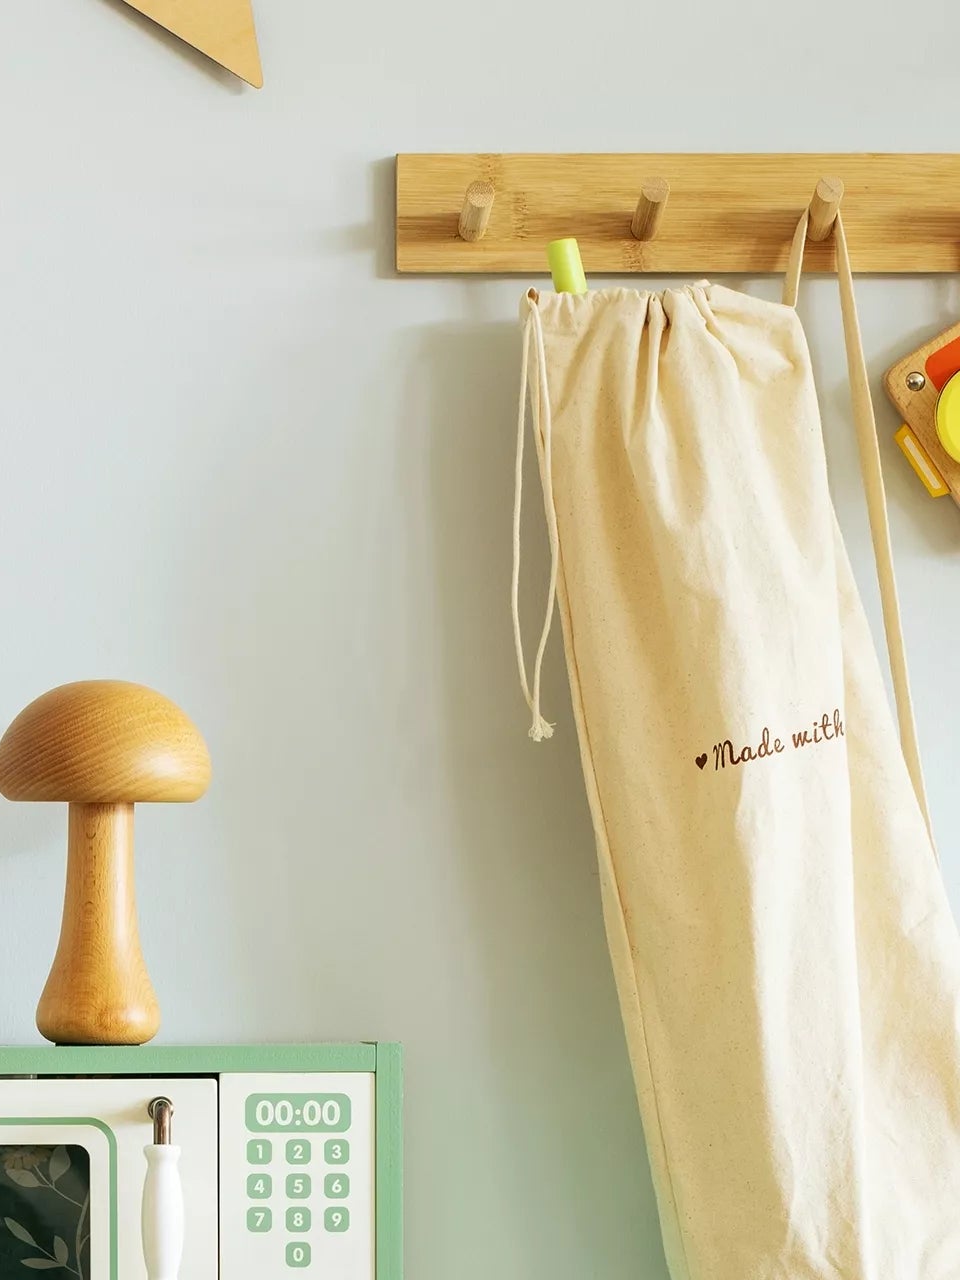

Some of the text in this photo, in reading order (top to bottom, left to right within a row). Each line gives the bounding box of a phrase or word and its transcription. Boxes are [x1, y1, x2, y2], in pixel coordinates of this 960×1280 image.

[712, 708, 845, 771] Made with
[255, 1100, 341, 1126] 00:00
[256, 1144, 342, 1159] 1 2 3
[254, 1179, 342, 1193] 4 5 6
[255, 1213, 342, 1227] 7 8 9
